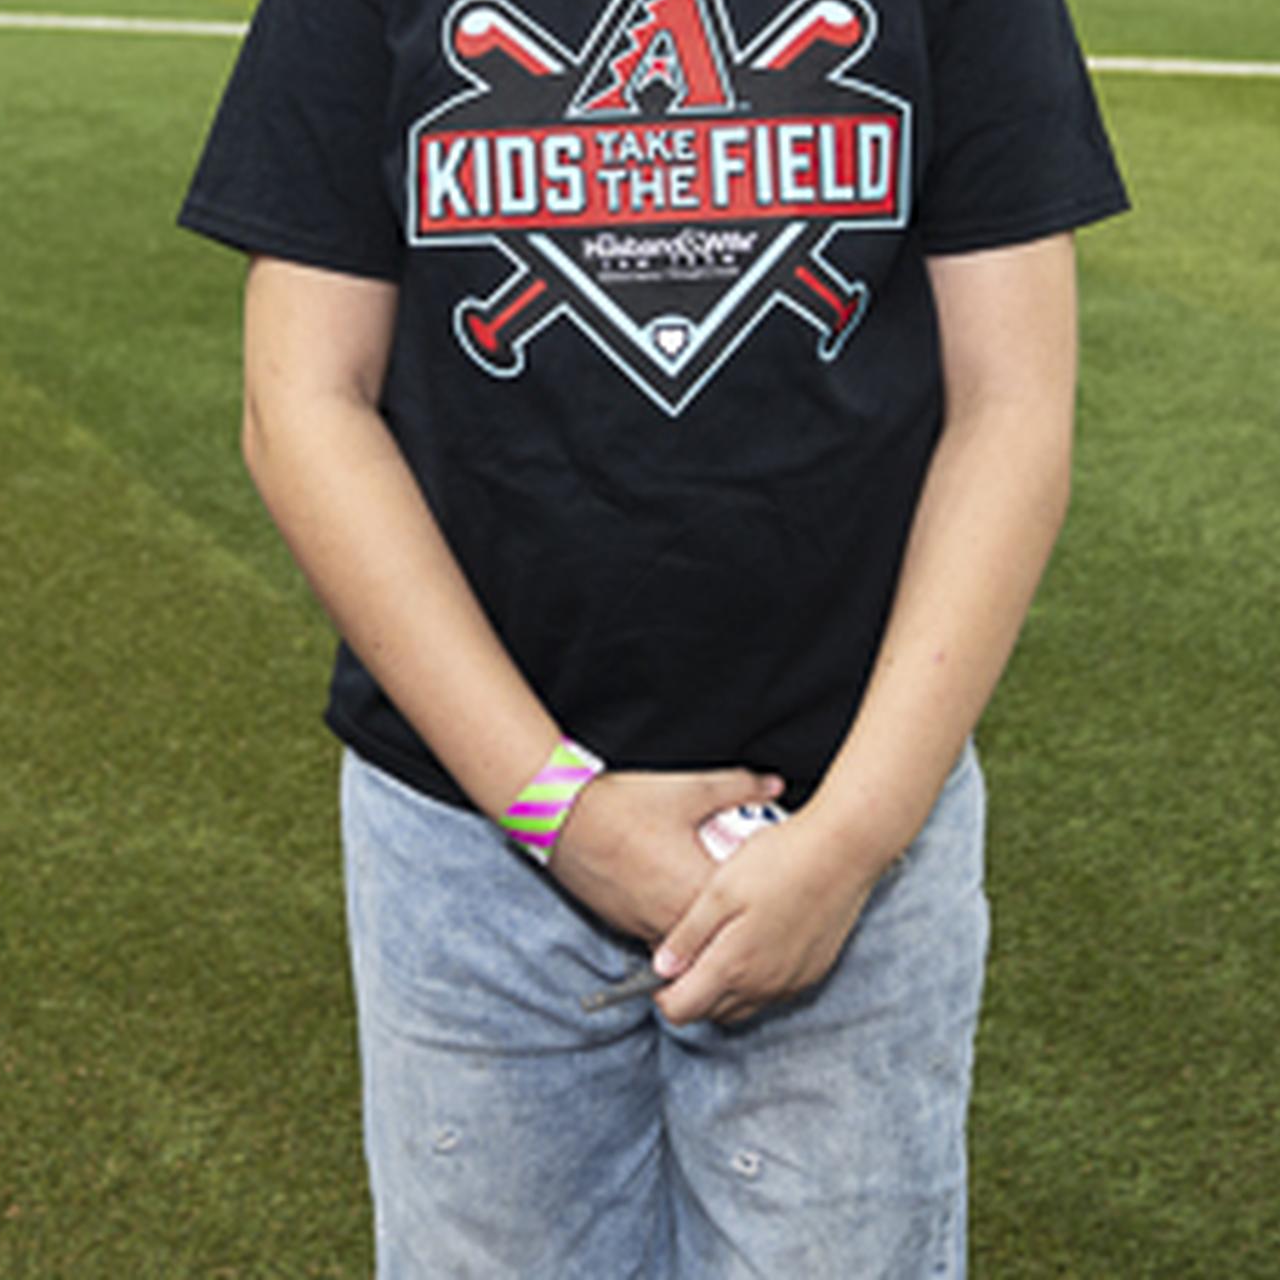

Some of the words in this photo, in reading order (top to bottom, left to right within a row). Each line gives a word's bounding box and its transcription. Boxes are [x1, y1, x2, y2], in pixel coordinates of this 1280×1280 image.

[425, 133, 586, 217] KIDS
[594, 128, 698, 164] TAKE
[710, 123, 892, 208] FIELD
[595, 167, 701, 211] THE
